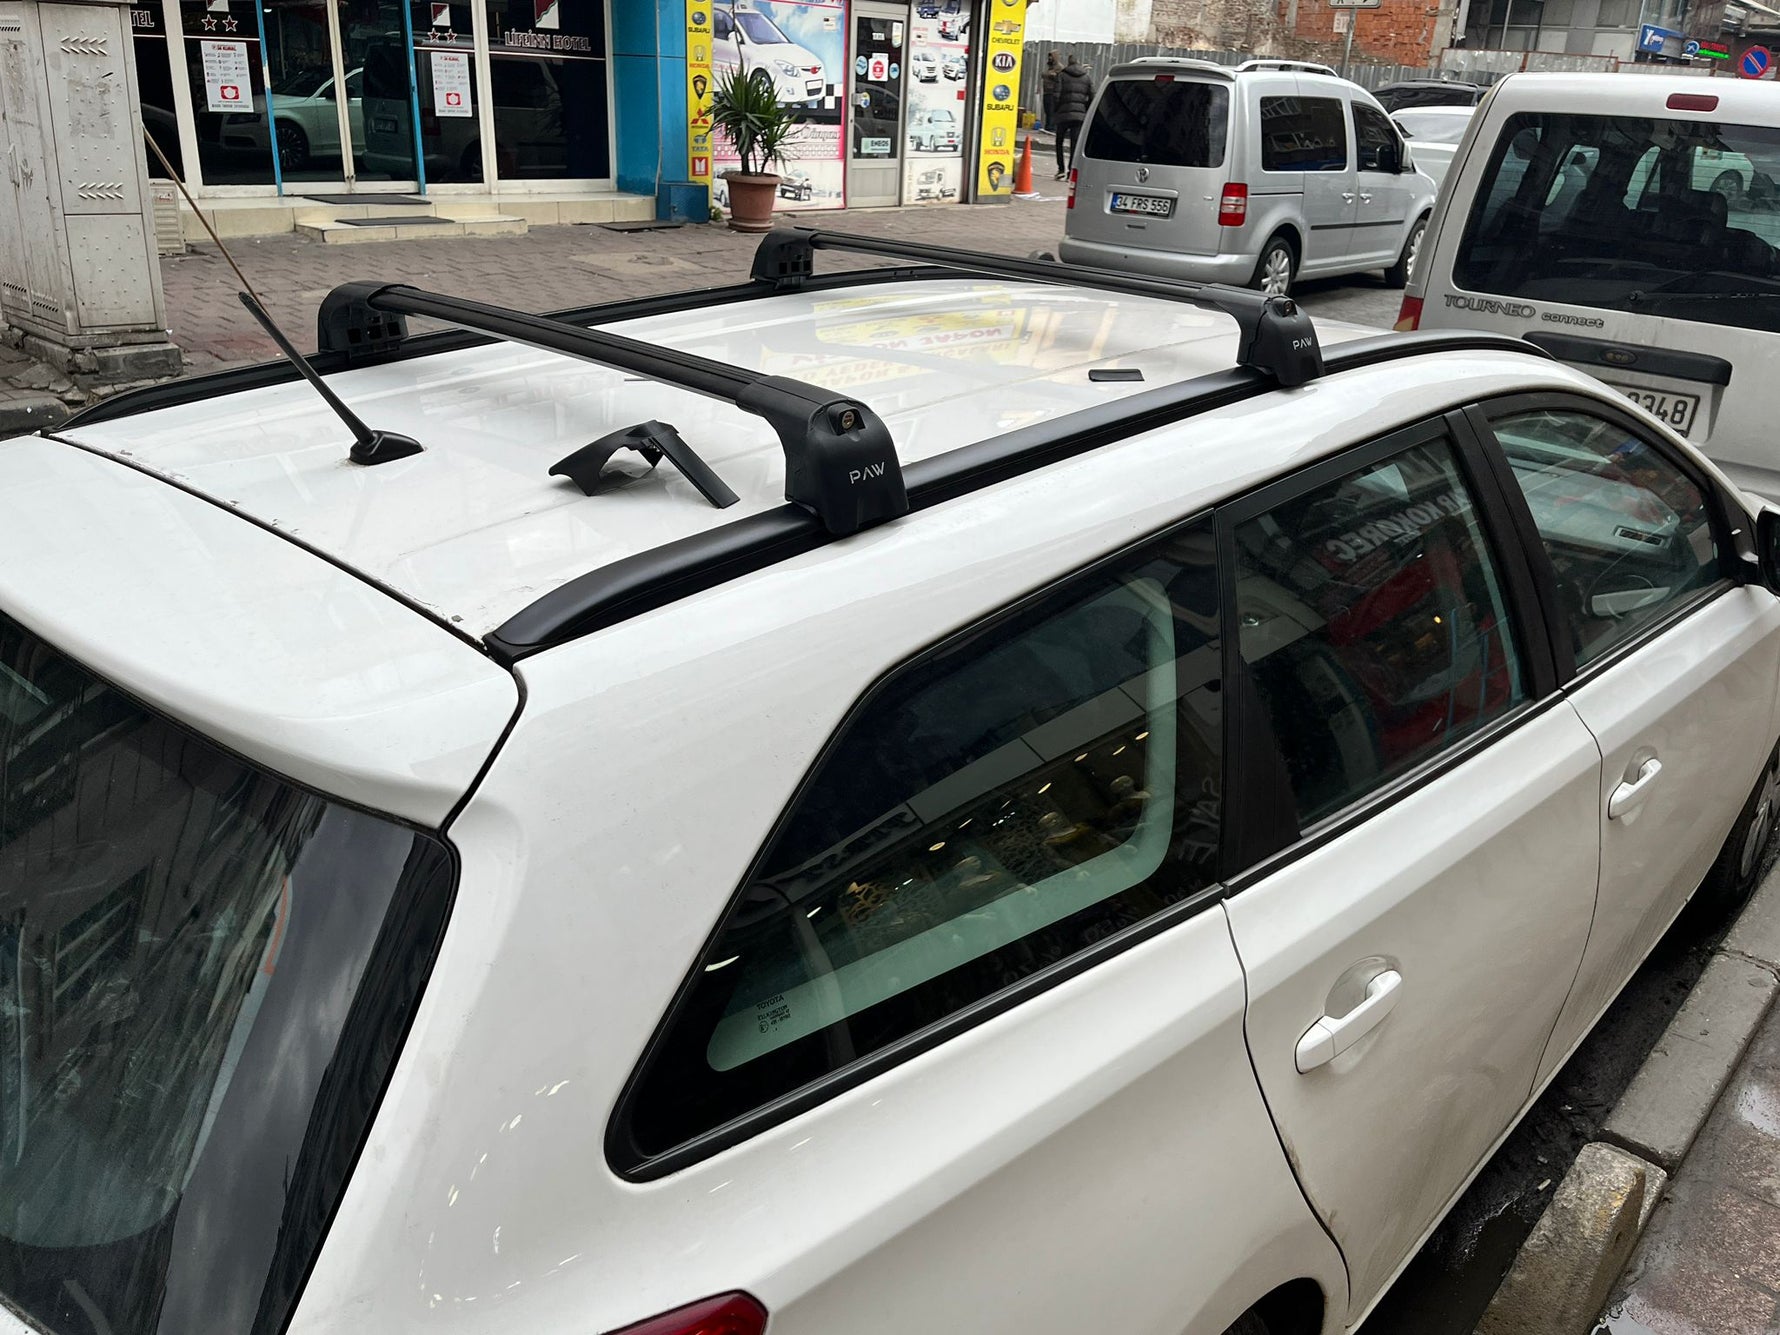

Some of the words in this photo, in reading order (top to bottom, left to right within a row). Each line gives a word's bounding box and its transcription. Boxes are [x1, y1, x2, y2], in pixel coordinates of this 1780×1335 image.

[553, 35, 592, 52] HOTEL
[994, 55, 1014, 68] KIA
[986, 103, 1015, 111] SUBARU
[1116, 196, 1128, 208] 34
[1130, 197, 1149, 210] FRS
[1444, 294, 1536, 318] TOURNEO
[1541, 312, 1605, 328] connect
[1292, 337, 1312, 350] PAW
[849, 462, 885, 484] PAW
[756, 994, 784, 1011] TOYOTA
